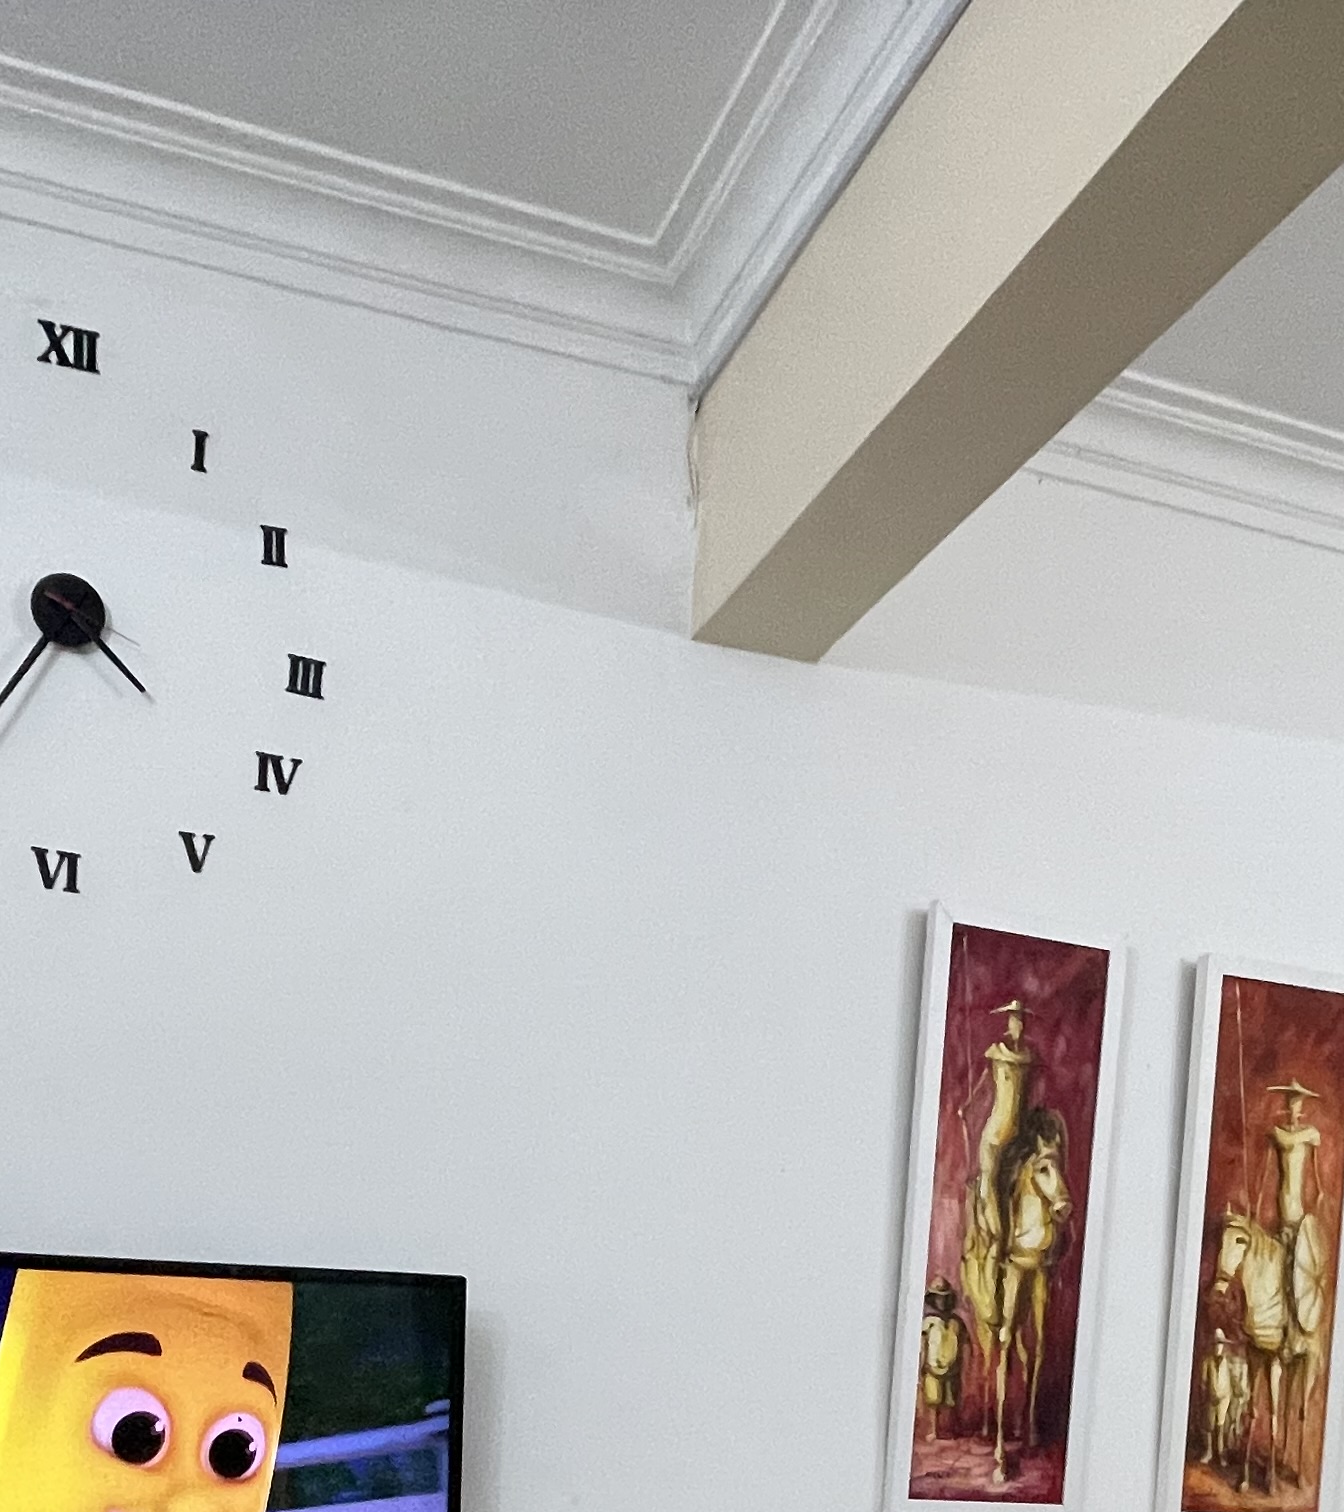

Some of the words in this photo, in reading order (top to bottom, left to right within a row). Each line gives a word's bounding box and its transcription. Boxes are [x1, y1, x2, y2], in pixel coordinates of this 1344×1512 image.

[37, 318, 100, 375] XII
[191, 429, 209, 474] I
[260, 524, 288, 568] II
[285, 653, 326, 700] III
[254, 750, 303, 796] IV
[30, 845, 81, 894] VI
[178, 830, 216, 874] V
